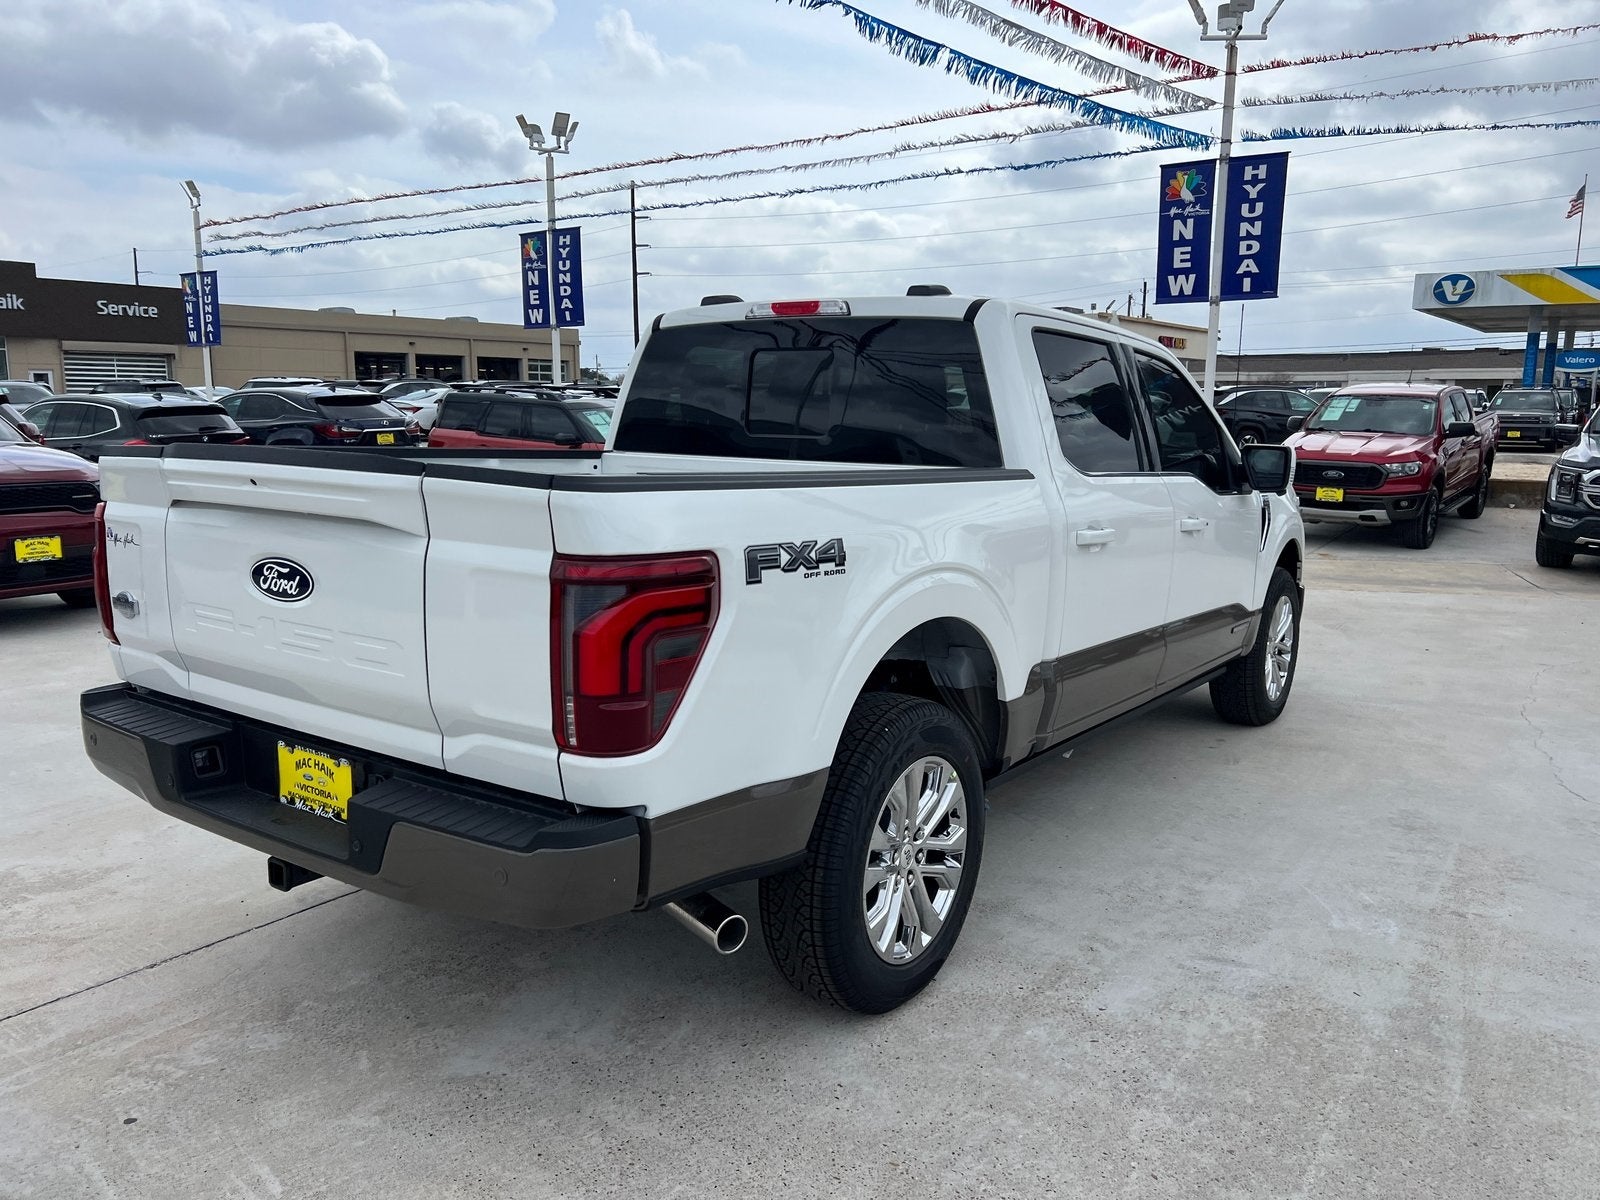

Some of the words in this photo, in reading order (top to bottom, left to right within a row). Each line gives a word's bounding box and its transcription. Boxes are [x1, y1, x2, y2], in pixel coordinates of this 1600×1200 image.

[1236, 164, 1268, 293] HYUNDAI
[558, 234, 573, 322] HYUNDAI
[1167, 218, 1196, 297] NEW
[97, 300, 158, 318] Service
[204, 276, 214, 341] HYUNDAI
[527, 270, 543, 324] NEW
[186, 302, 197, 343] NEW
[1564, 356, 1596, 364] Valero
[260, 563, 300, 595] Ford
[744, 538, 847, 585] FX4
[824, 568, 846, 577] ROAD
[295, 757, 313, 772] MAC
[313, 758, 335, 782] HAIK
[299, 783, 333, 800] VICTORIA
